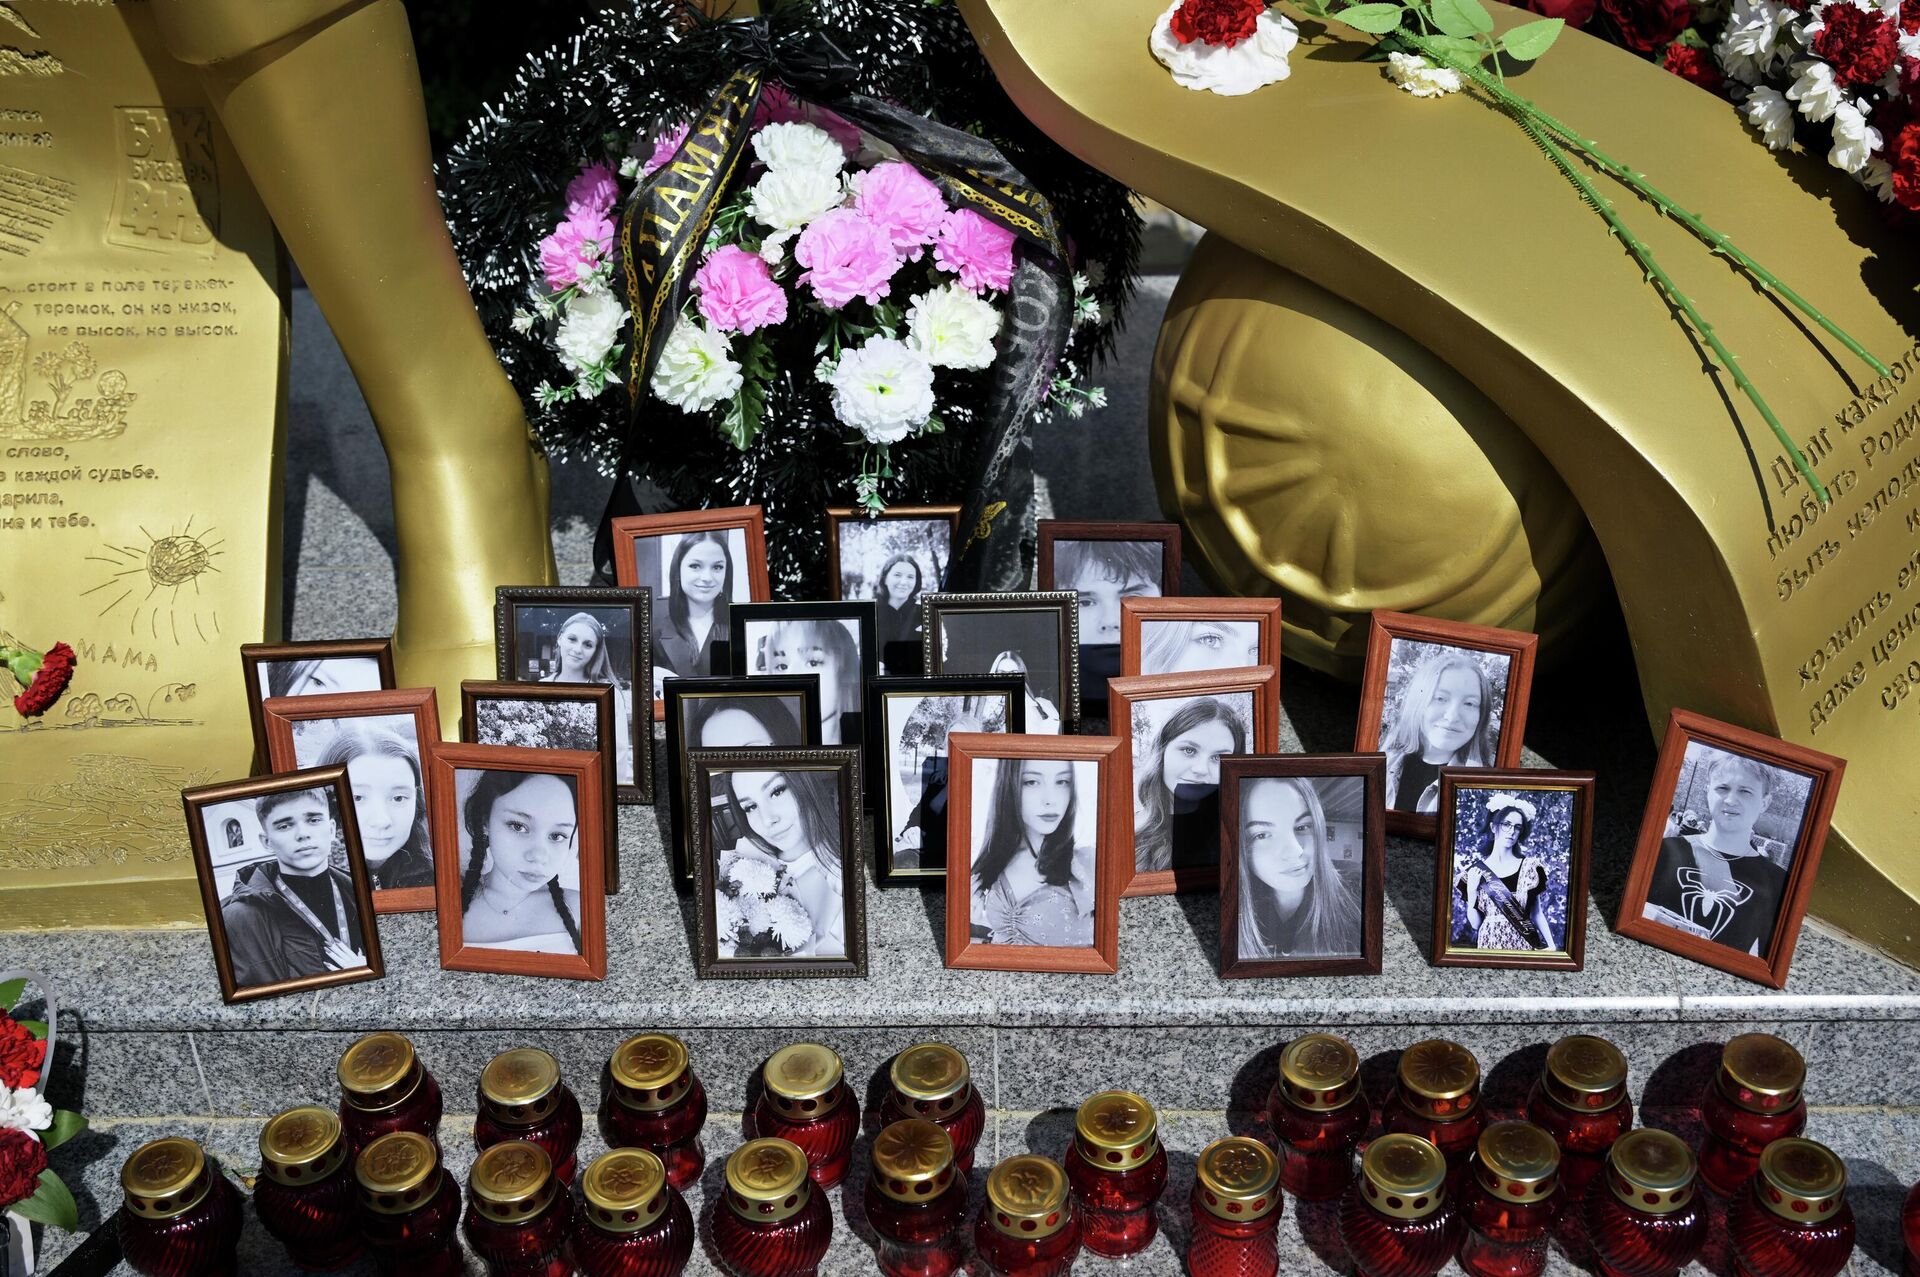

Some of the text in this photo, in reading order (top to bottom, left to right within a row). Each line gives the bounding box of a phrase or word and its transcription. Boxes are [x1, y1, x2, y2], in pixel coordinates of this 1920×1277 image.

[102, 280, 145, 292] поле
[34, 303, 114, 317] теремок,
[122, 303, 144, 315] он
[179, 301, 237, 315] низок,
[48, 325, 69, 336] не
[175, 324, 238, 336] высок.
[1860, 400, 1920, 470] Роди
[6, 446, 70, 461] слово,
[15, 465, 82, 483] каждой
[88, 464, 159, 483] судьбе.
[0, 493, 63, 509] арила,
[0, 513, 96, 529] не и тебе.
[1776, 540, 1841, 601] быть
[76, 638, 158, 672] МАМА
[1810, 661, 1866, 735] даже
